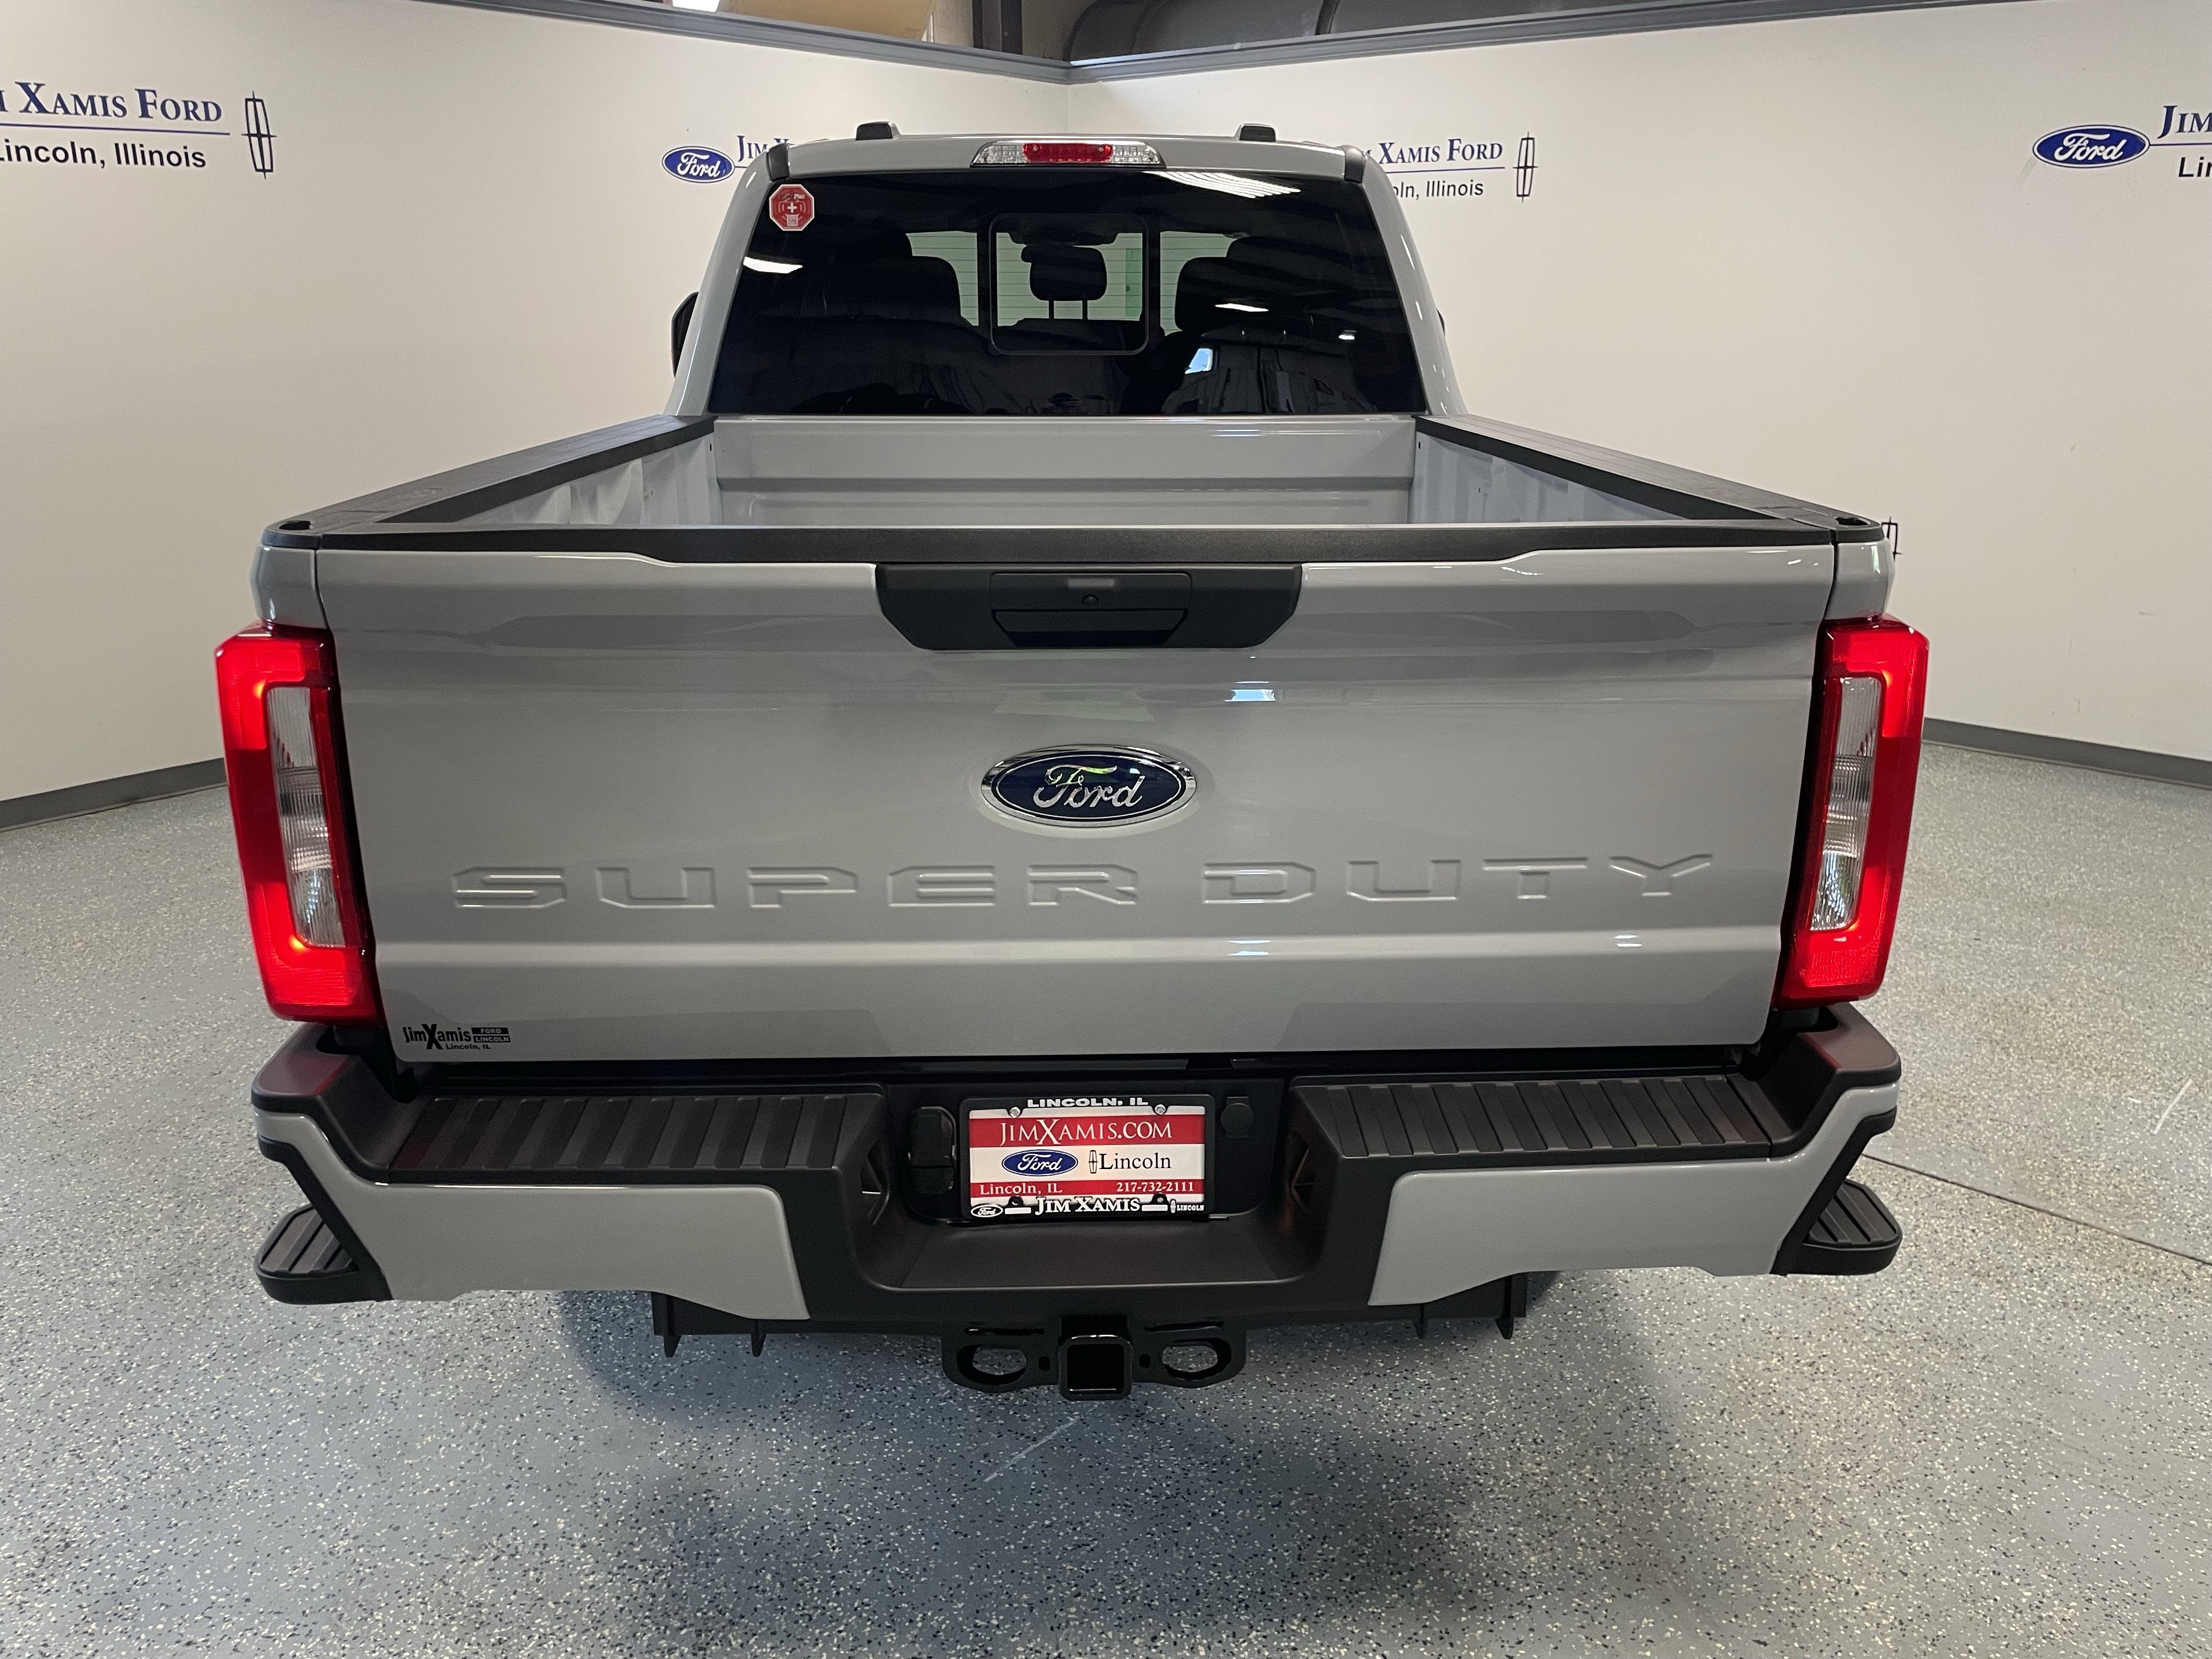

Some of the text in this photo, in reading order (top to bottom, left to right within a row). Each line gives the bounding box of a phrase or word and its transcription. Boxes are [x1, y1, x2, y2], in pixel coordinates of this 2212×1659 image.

[134, 88, 222, 122] FORD
[0, 138, 206, 168] incoln, Illinois
[1447, 139, 1503, 161] FORD
[2054, 133, 2127, 161] Ford
[677, 152, 720, 177] Ford
[1426, 179, 1483, 198] Illinois
[1034, 764, 1146, 808] Ford
[453, 853, 1713, 909] SUPER DUTY
[1028, 1097, 1149, 1108] LINCOLN, IL
[1017, 1154, 1062, 1171] Ford
[1099, 1153, 1172, 1170] Lincoln
[980, 1183, 1063, 1195] Lincoln, IL
[1116, 1181, 1194, 1193] 217-732-2111
[1035, 1197, 1141, 1215] JIM XAMIS
